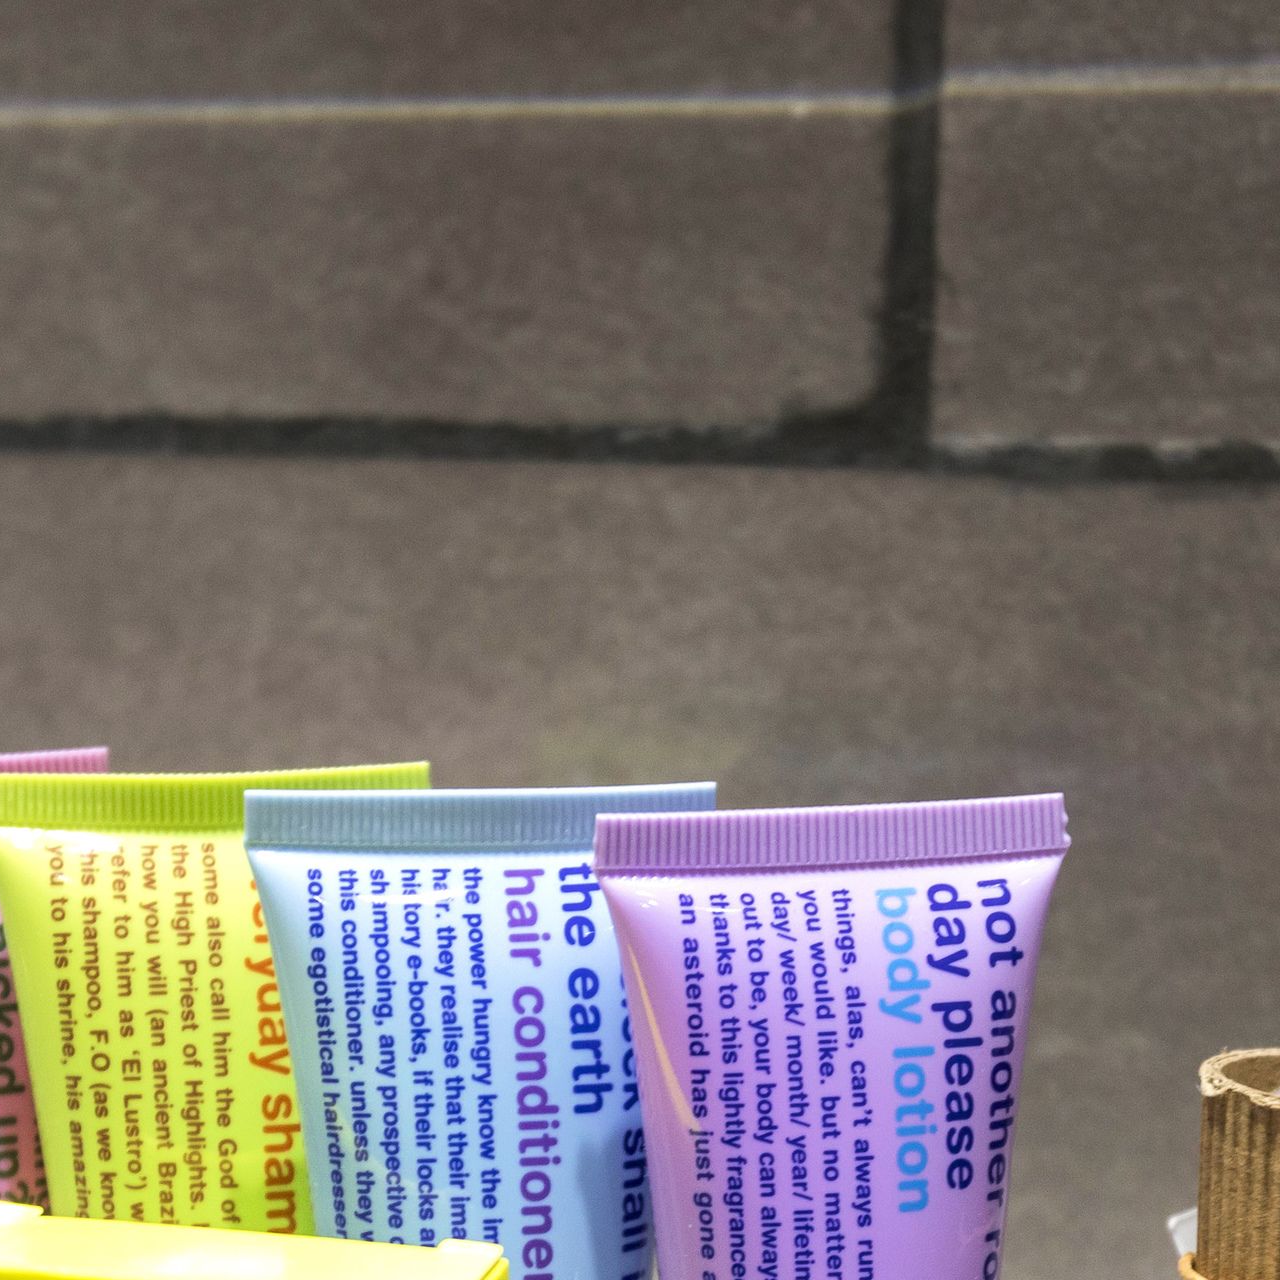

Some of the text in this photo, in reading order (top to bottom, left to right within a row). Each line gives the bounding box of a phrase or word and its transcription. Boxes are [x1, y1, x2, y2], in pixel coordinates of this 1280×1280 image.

[308, 869, 324, 938] some
[504, 869, 550, 967] hair
[679, 894, 696, 924] an
[709, 893, 736, 976] thanks
[740, 893, 762, 930] out
[770, 892, 797, 942] day/
[796, 890, 821, 931] you
[832, 889, 856, 973] things,
[977, 879, 1024, 968] not
[747, 938, 765, 963] to
[810, 942, 836, 1019] would
[139, 845, 174, 1149] how you will (an ancient
[308, 947, 339, 1084] egotistical
[559, 863, 613, 1114] the earth
[683, 938, 710, 1056] asteroid
[719, 984, 738, 1009] to
[749, 971, 769, 1010] be,
[779, 950, 805, 1026] week/
[845, 986, 866, 1048] alas,
[201, 843, 241, 1223] some also call him the God of
[339, 869, 375, 1223] this conditioner. unless they
[462, 867, 501, 1209] the power hungry know the
[720, 1017, 742, 1064] this
[748, 1018, 771, 1075] your
[817, 1031, 838, 1084] like.
[876, 887, 935, 1213] body lotion
[926, 883, 983, 1190] day please
[691, 1069, 711, 1118] has
[718, 1072, 746, 1149] lightly
[753, 1083, 778, 1144] body
[786, 1035, 810, 1127] month/
[986, 990, 1016, 1207] another
[821, 1096, 841, 1139] but
[689, 1129, 715, 1181] just
[759, 1152, 775, 1197] can
[786, 1135, 813, 1201] year/
[823, 1150, 839, 1181] no
[852, 1139, 874, 1228] always
[693, 1192, 715, 1260] gone
[825, 1193, 845, 1280] matter
